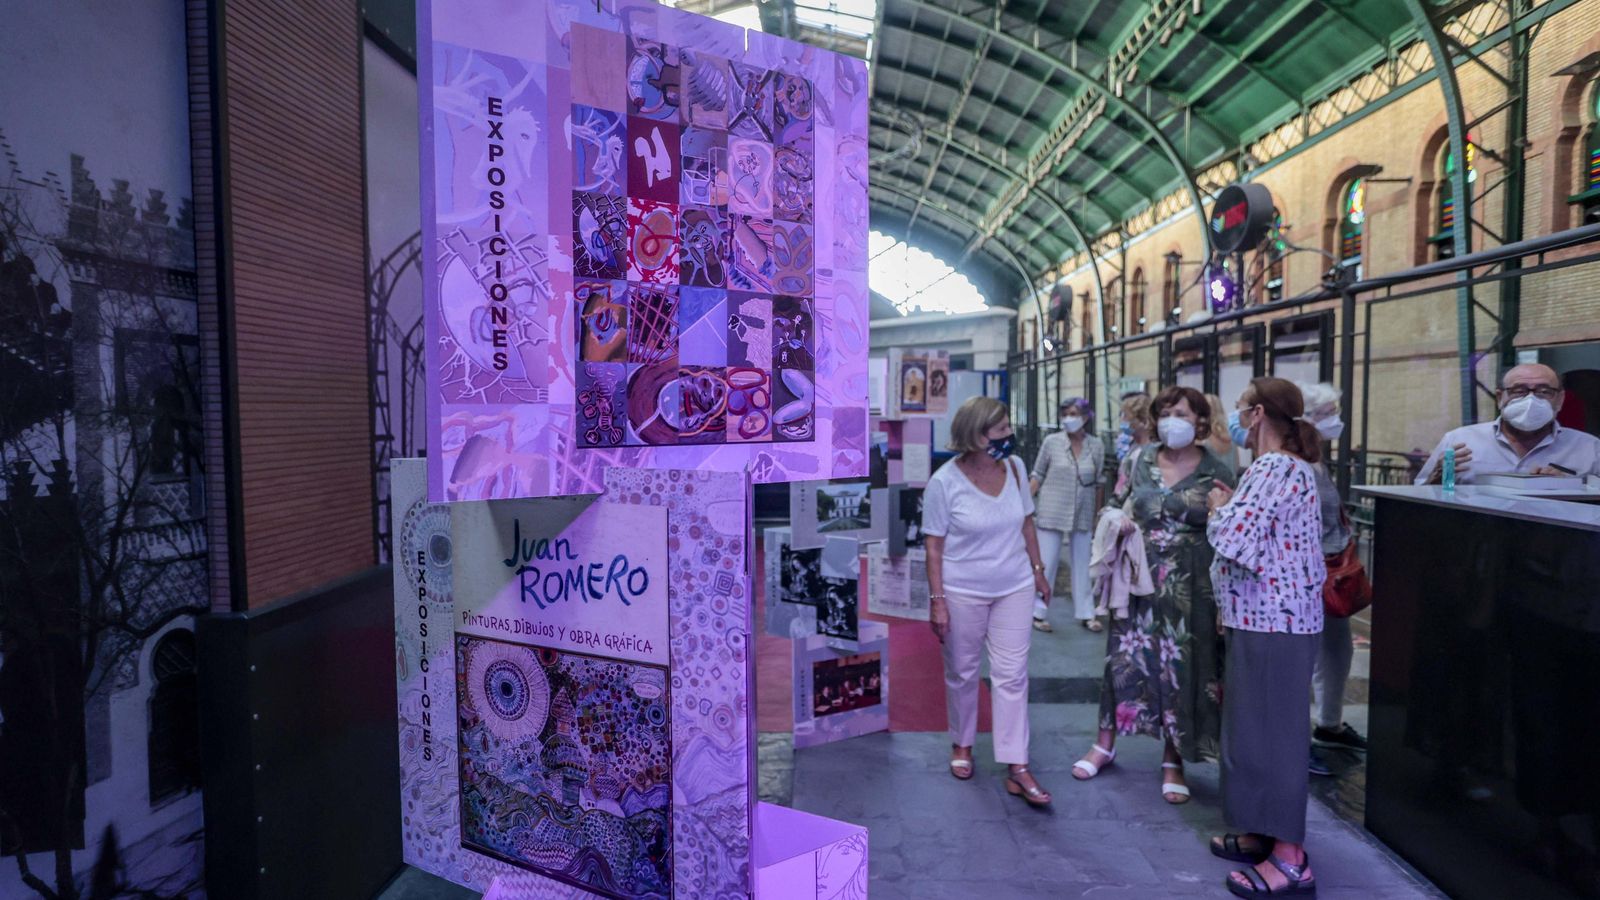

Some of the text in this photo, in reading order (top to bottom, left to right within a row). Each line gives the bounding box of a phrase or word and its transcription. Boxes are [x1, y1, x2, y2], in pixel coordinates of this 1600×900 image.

[487, 97, 508, 371] EXPOSICIONES
[503, 518, 579, 567] Juan
[515, 554, 649, 610] ROMERO
[417, 551, 432, 761] EXPOSICIONES
[558, 624, 566, 641] Y
[569, 630, 600, 648] OBRA
